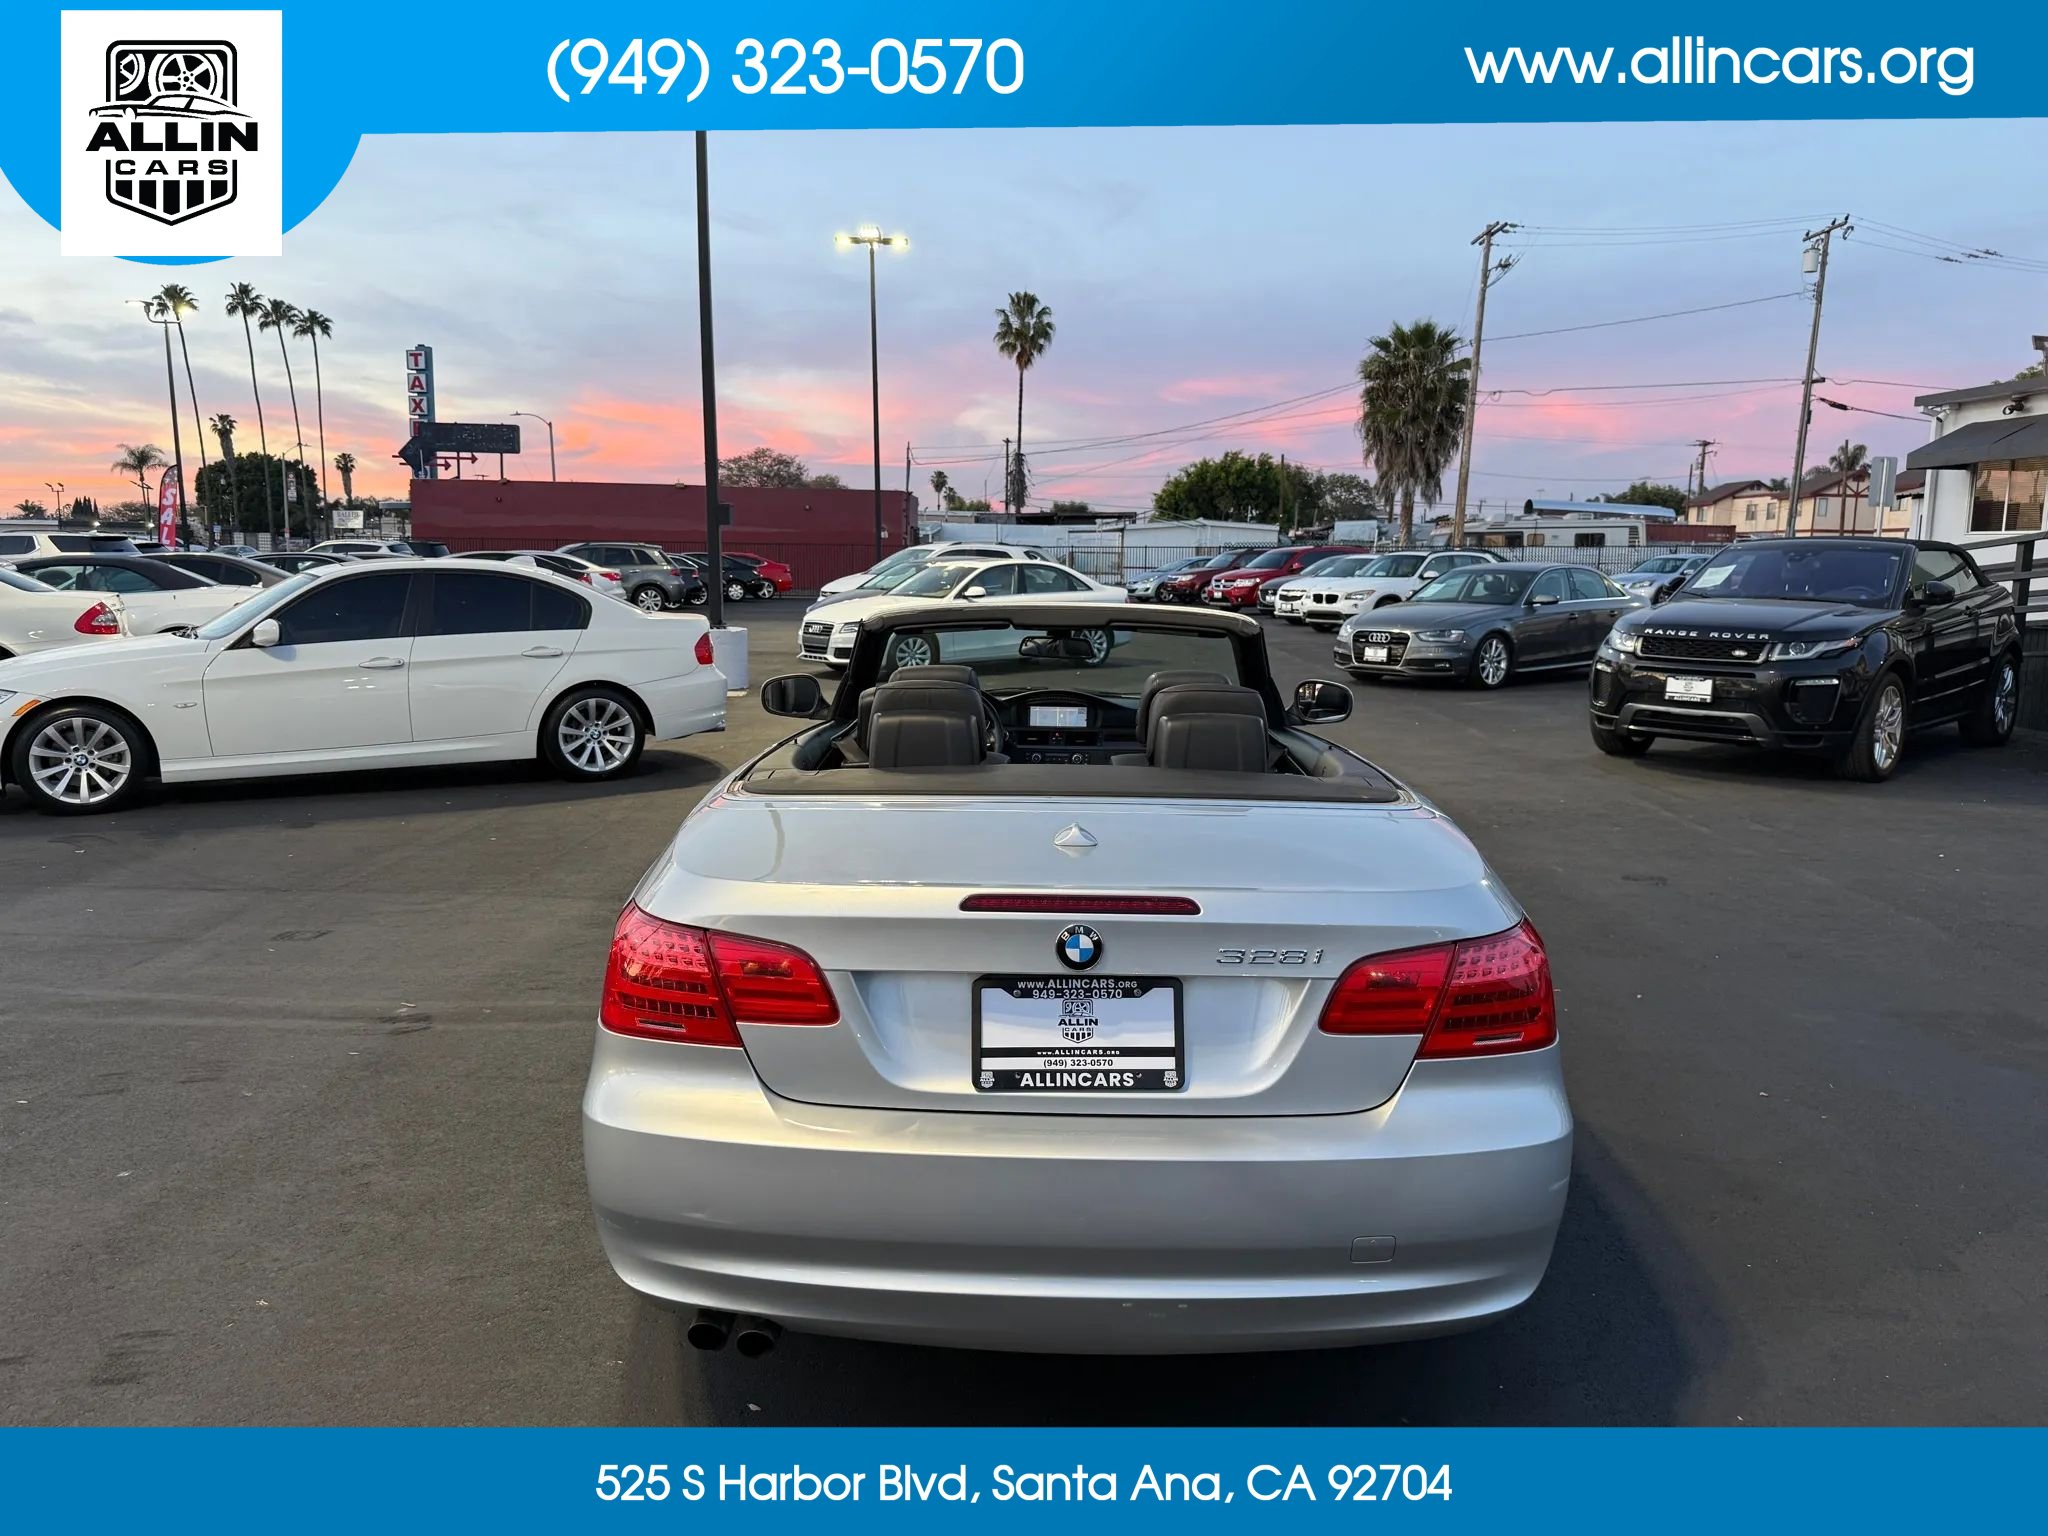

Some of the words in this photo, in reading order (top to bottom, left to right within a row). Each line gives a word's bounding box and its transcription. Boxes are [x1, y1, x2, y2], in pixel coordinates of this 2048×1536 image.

[161, 488, 177, 545] SAL
[1644, 628, 1699, 637] RANGE
[1709, 631, 1770, 640] ROVER
[1061, 926, 1099, 941] BMW
[1216, 948, 1324, 965] 328i
[1032, 989, 1123, 999] 949-323-0570
[1058, 1018, 1098, 1026] ALLIN
[1043, 1058, 1068, 1068] (949)
[1070, 1057, 1114, 1067] 323-0570
[1020, 1072, 1135, 1087] ALLINCARS
